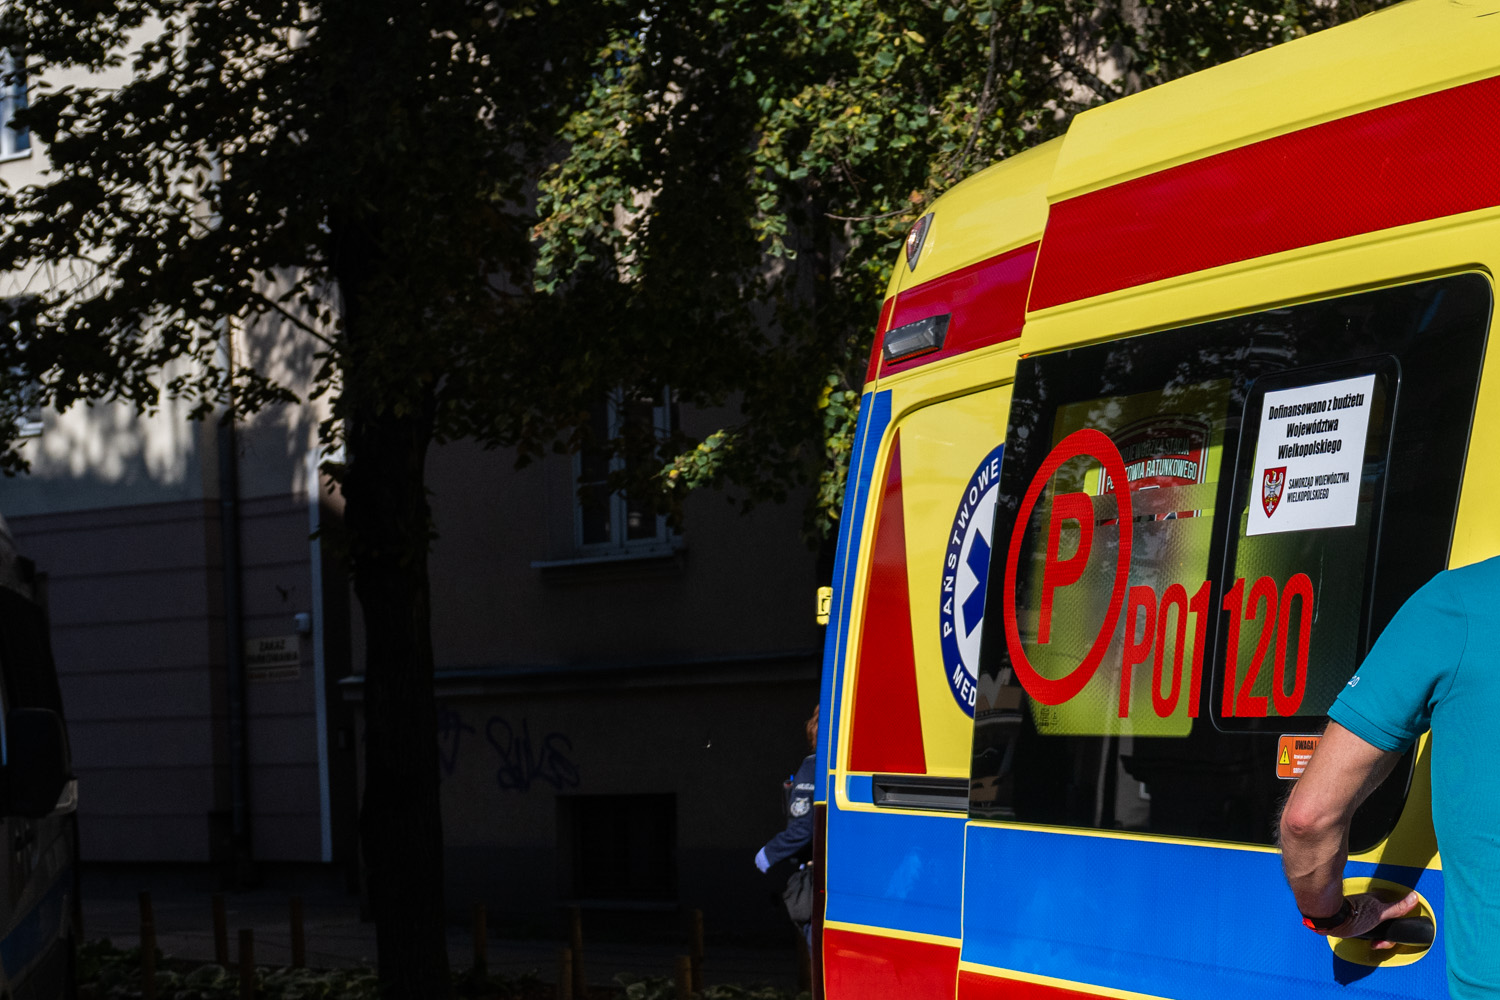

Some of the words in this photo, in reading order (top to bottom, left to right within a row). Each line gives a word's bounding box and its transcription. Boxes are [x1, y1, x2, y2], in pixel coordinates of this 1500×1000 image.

[1268, 400, 1327, 421] Dofinansowano
[1327, 398, 1333, 411] z
[1333, 393, 1365, 410] budżetu
[1286, 419, 1339, 438] Województwa
[1278, 439, 1342, 460] Wielkopolskiego
[1145, 459, 1198, 480] RATUNKOWEGO
[1288, 477, 1313, 490] SAMORZĄD
[1314, 472, 1350, 487] WOJEWÓDZTWA
[1287, 488, 1330, 503] WIELKOPOLSKIEGO
[943, 457, 999, 638] PAŃSTWOWE
[1037, 491, 1094, 645] P
[1118, 580, 1212, 719] P01
[1221, 573, 1314, 719] 120
[1295, 740, 1313, 750] UWAGA
